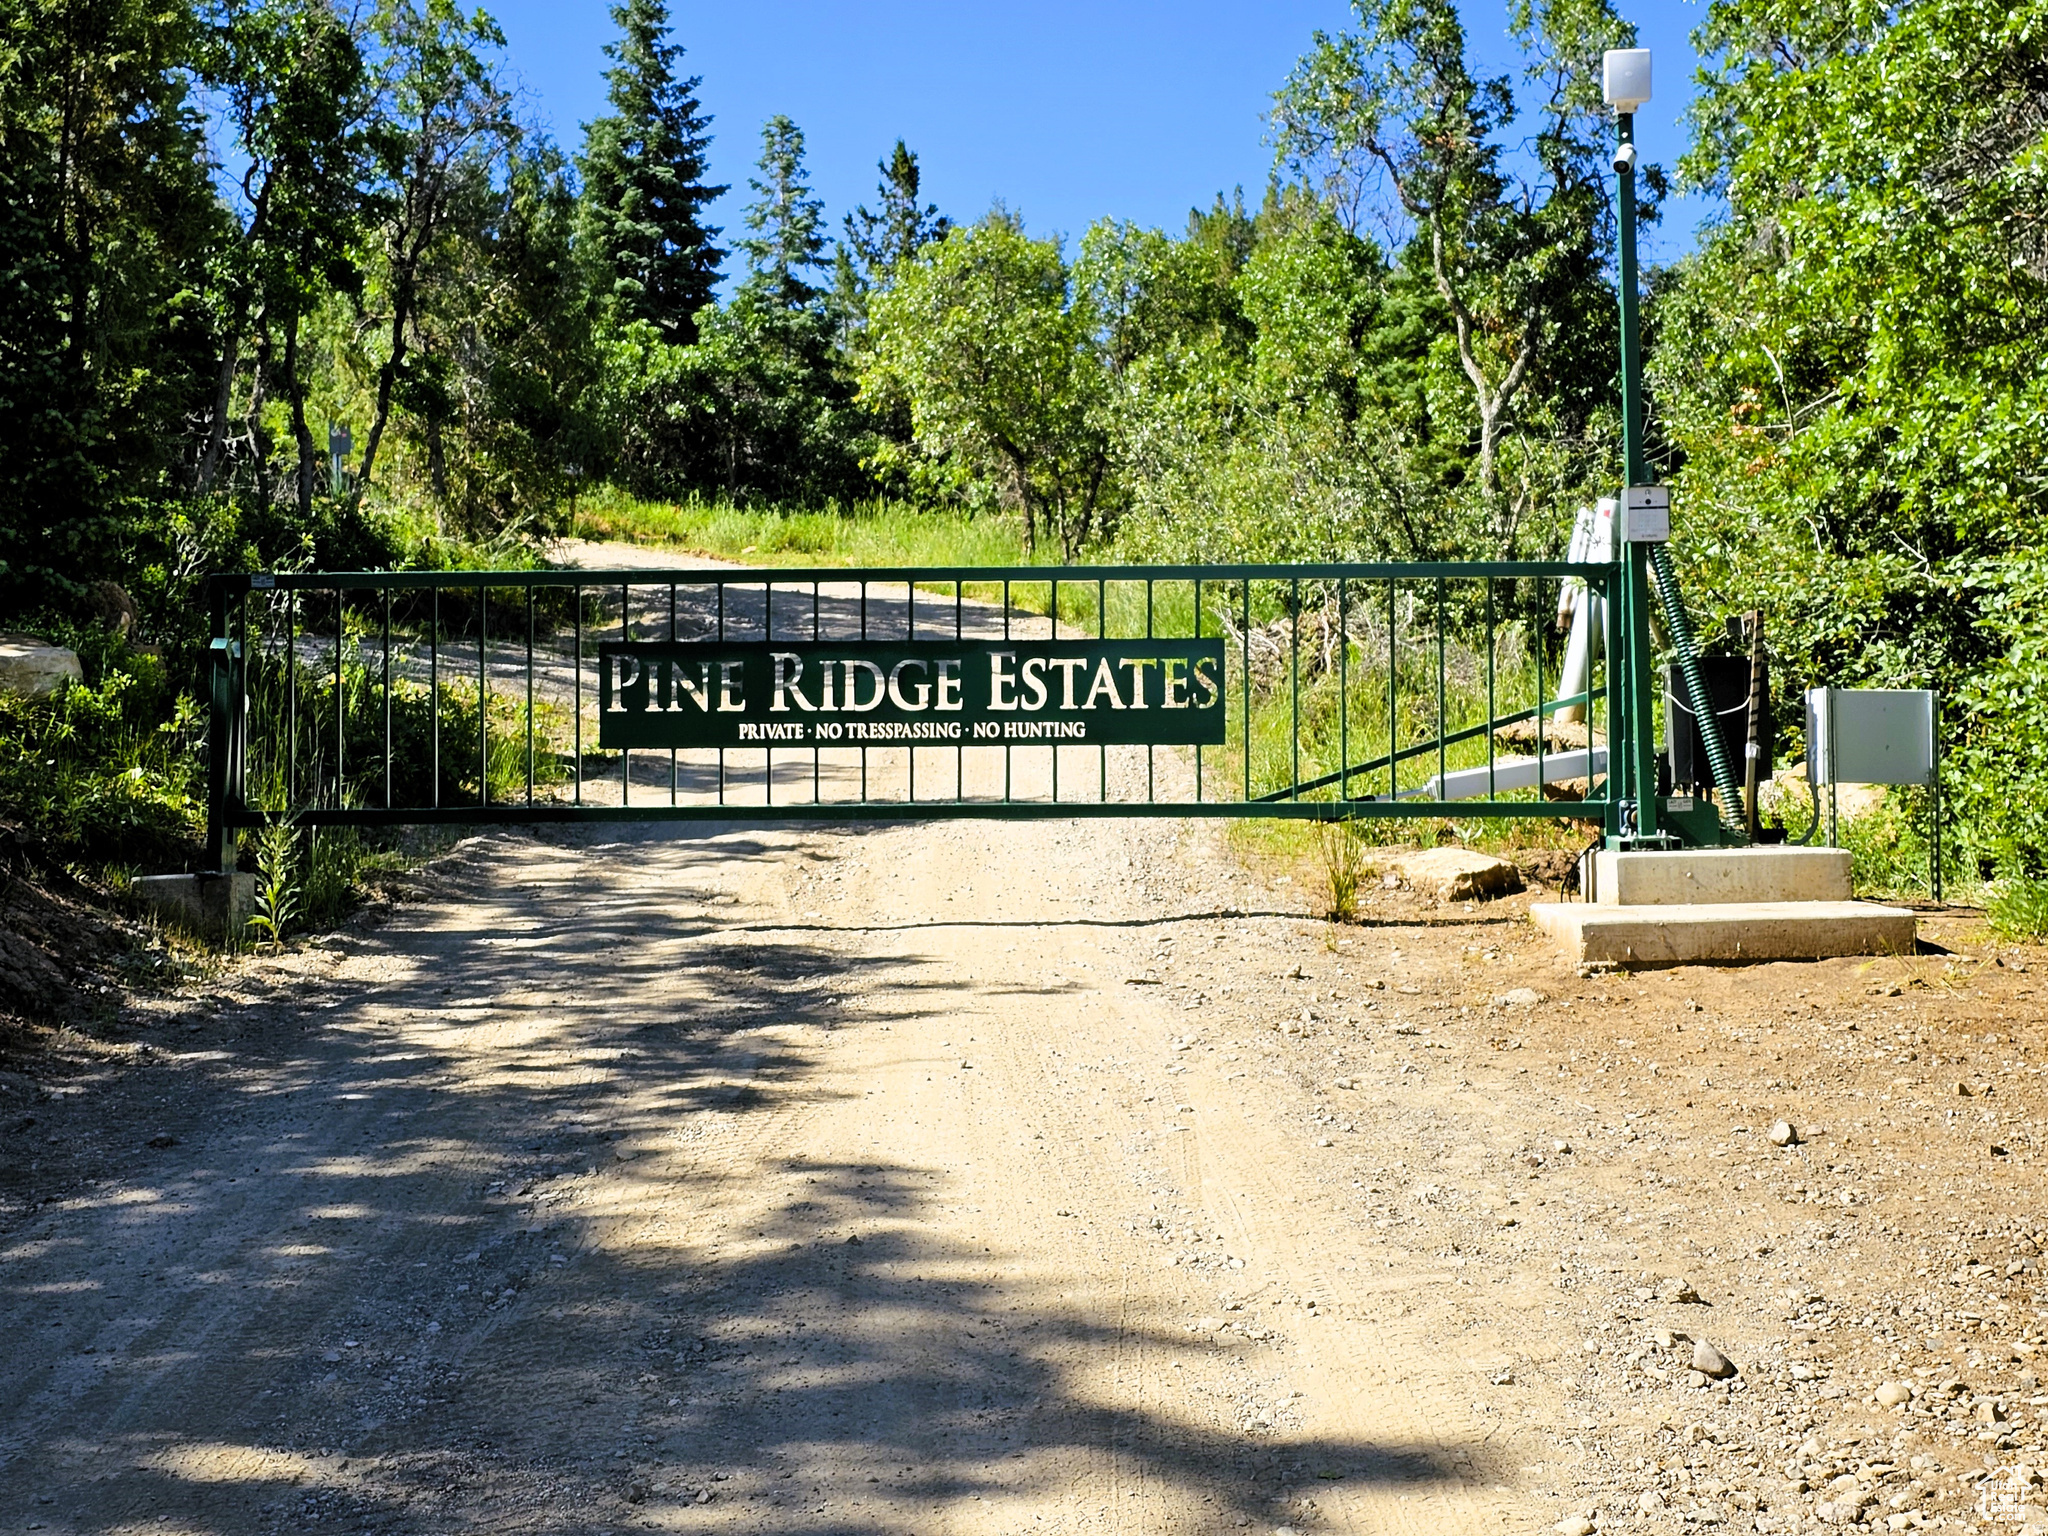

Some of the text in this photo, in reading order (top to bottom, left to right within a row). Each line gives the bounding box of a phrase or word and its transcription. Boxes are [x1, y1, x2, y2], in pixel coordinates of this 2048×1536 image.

[606, 650, 1218, 712] PINE RIDGE ESTATES
[739, 721, 1087, 741] PRIVATE NO TRESSPASSING NO HUNTING
